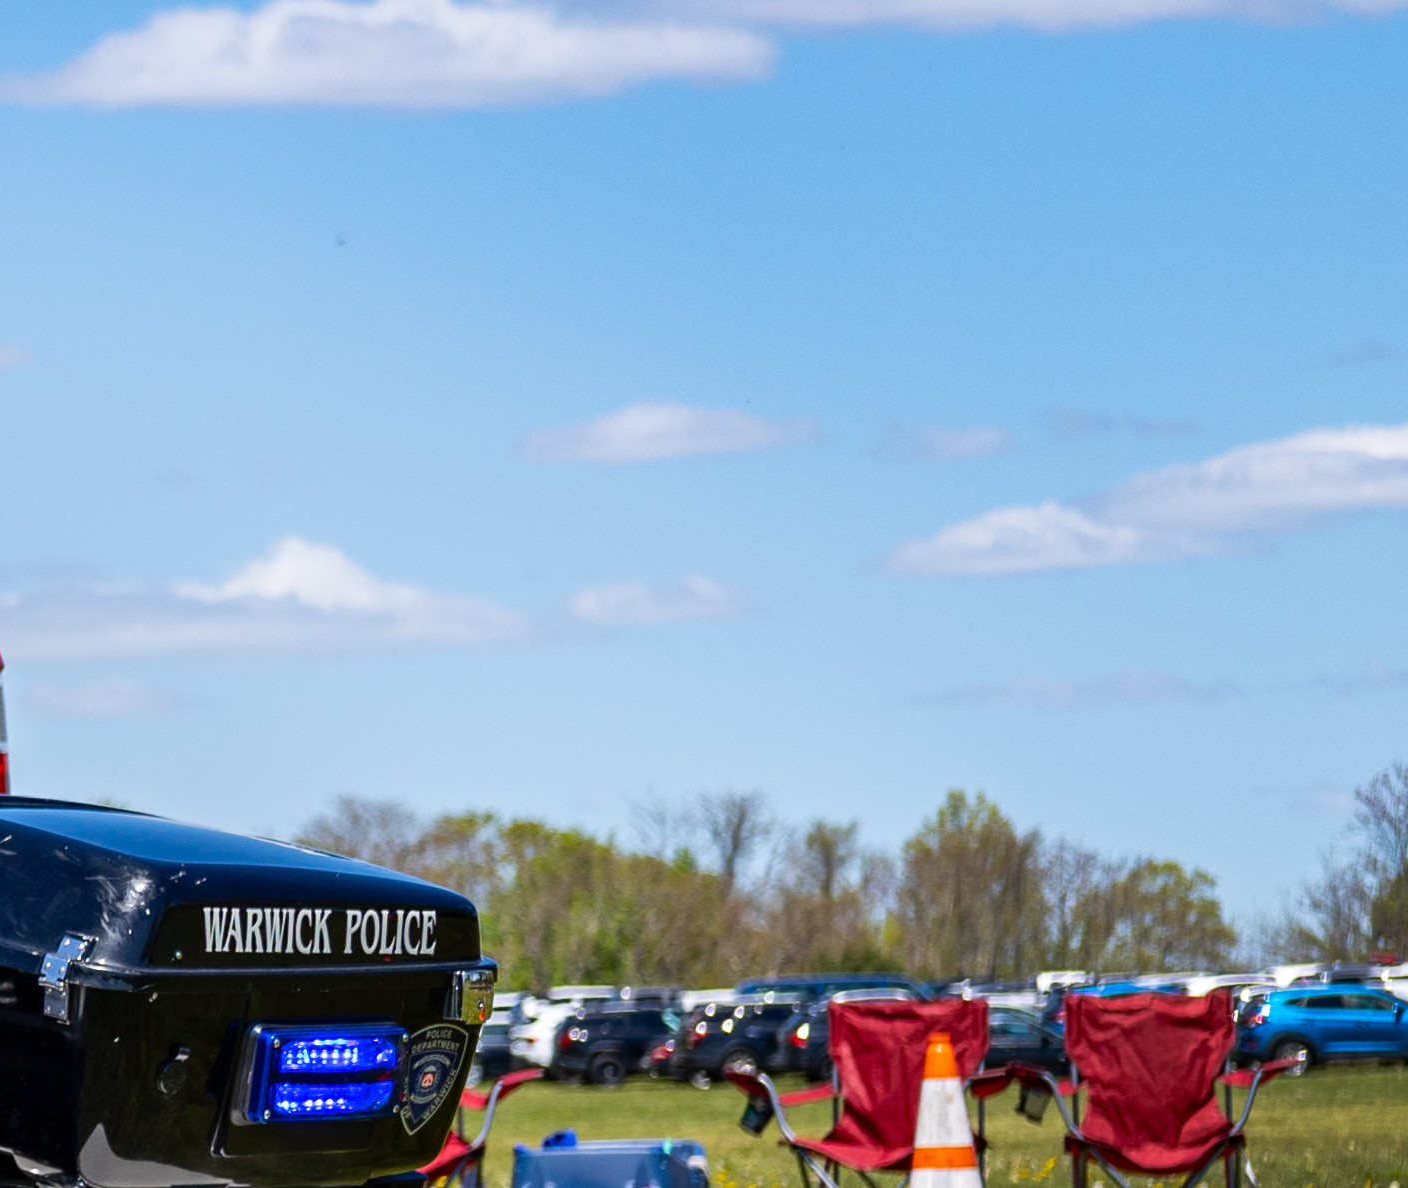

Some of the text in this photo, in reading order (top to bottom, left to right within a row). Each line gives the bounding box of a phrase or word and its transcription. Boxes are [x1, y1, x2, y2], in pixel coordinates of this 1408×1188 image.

[203, 907, 437, 955] WARWICK POLICE
[412, 1041, 460, 1054] DEPARTMENT
[426, 1030, 453, 1039] POLICE
[423, 1069, 456, 1119] WARWICK
